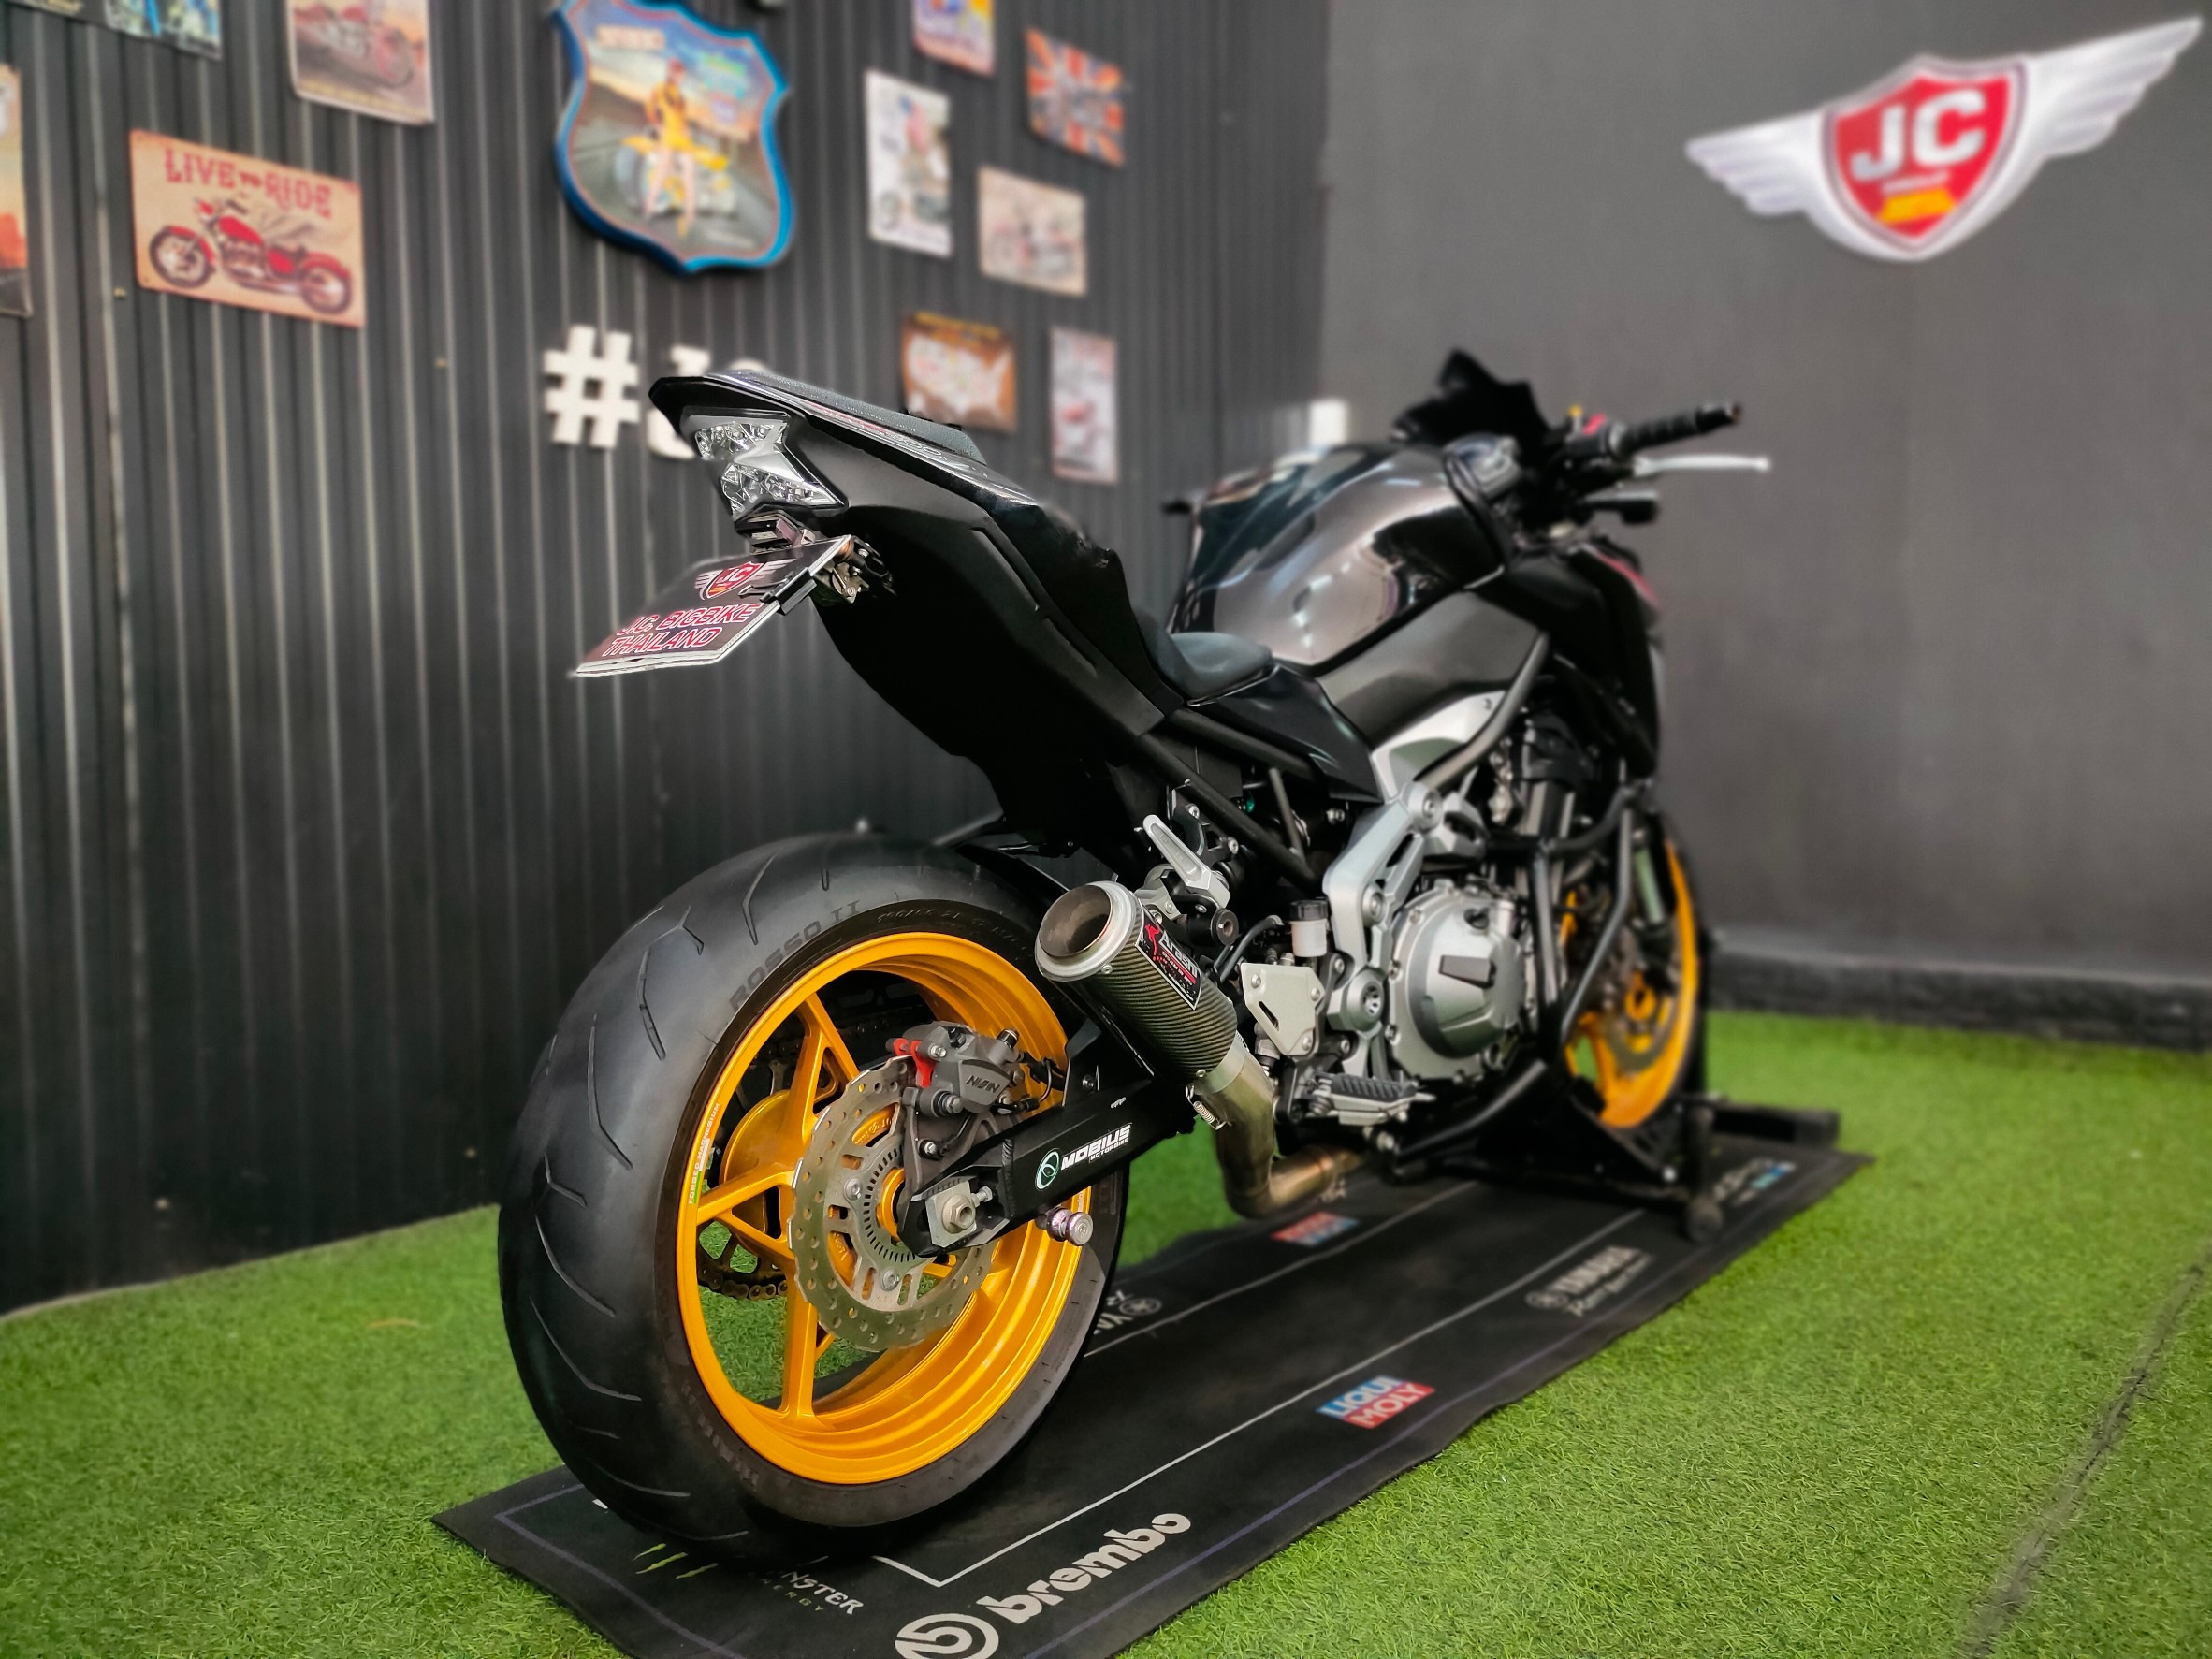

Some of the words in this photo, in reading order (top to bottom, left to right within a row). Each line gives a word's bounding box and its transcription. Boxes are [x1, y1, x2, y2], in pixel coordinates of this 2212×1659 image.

[1850, 89, 1986, 182] JC
[165, 148, 235, 189] LIVE
[265, 172, 331, 220] RIDE
[715, 565, 749, 584] JC
[656, 603, 764, 631] BIGBIKE
[602, 627, 723, 657] THAILAND
[728, 920, 822, 1013] ROSSO
[697, 1103, 720, 1160] MAGNESIUM
[1060, 1124, 1131, 1171] MOBIUS
[1090, 1137, 1129, 1161] MOTORBIKE
[1317, 1375, 1403, 1418] LIQUI
[1347, 1382, 1430, 1428] MOLY
[975, 1513, 1191, 1624] brembo
